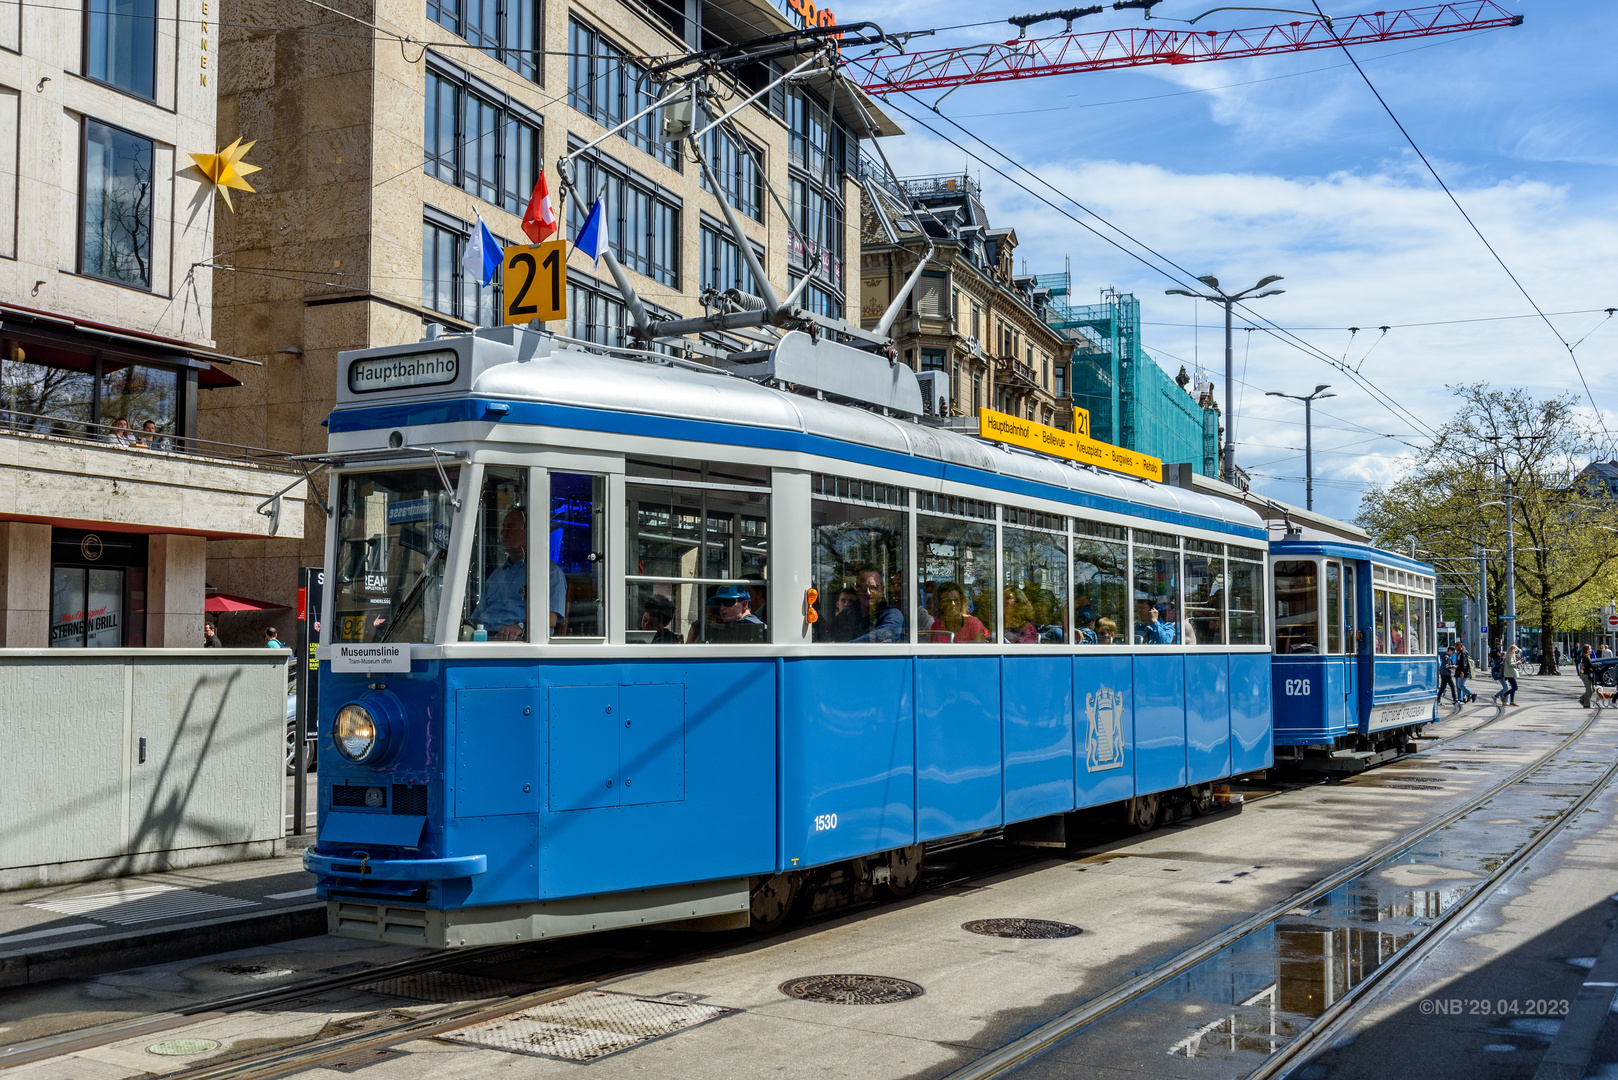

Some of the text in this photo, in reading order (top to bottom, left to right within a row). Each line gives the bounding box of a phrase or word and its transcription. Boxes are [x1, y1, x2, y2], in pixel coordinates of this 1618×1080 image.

[509, 249, 560, 316] 21
[355, 357, 456, 383] Hauptbahnho
[1078, 412, 1088, 435] 21
[988, 415, 1030, 438] Hauptbahnhof
[1042, 431, 1065, 448] Bellevue
[1076, 440, 1102, 458] Kreuzplatz
[1112, 450, 1133, 466] Burgwies
[1143, 459, 1158, 475] Rehalp
[62, 612, 74, 623] Das
[96, 613, 118, 631] GRILL
[341, 647, 399, 657] Museumslinie
[1286, 679, 1310, 696] 626
[814, 813, 838, 831] 1530
